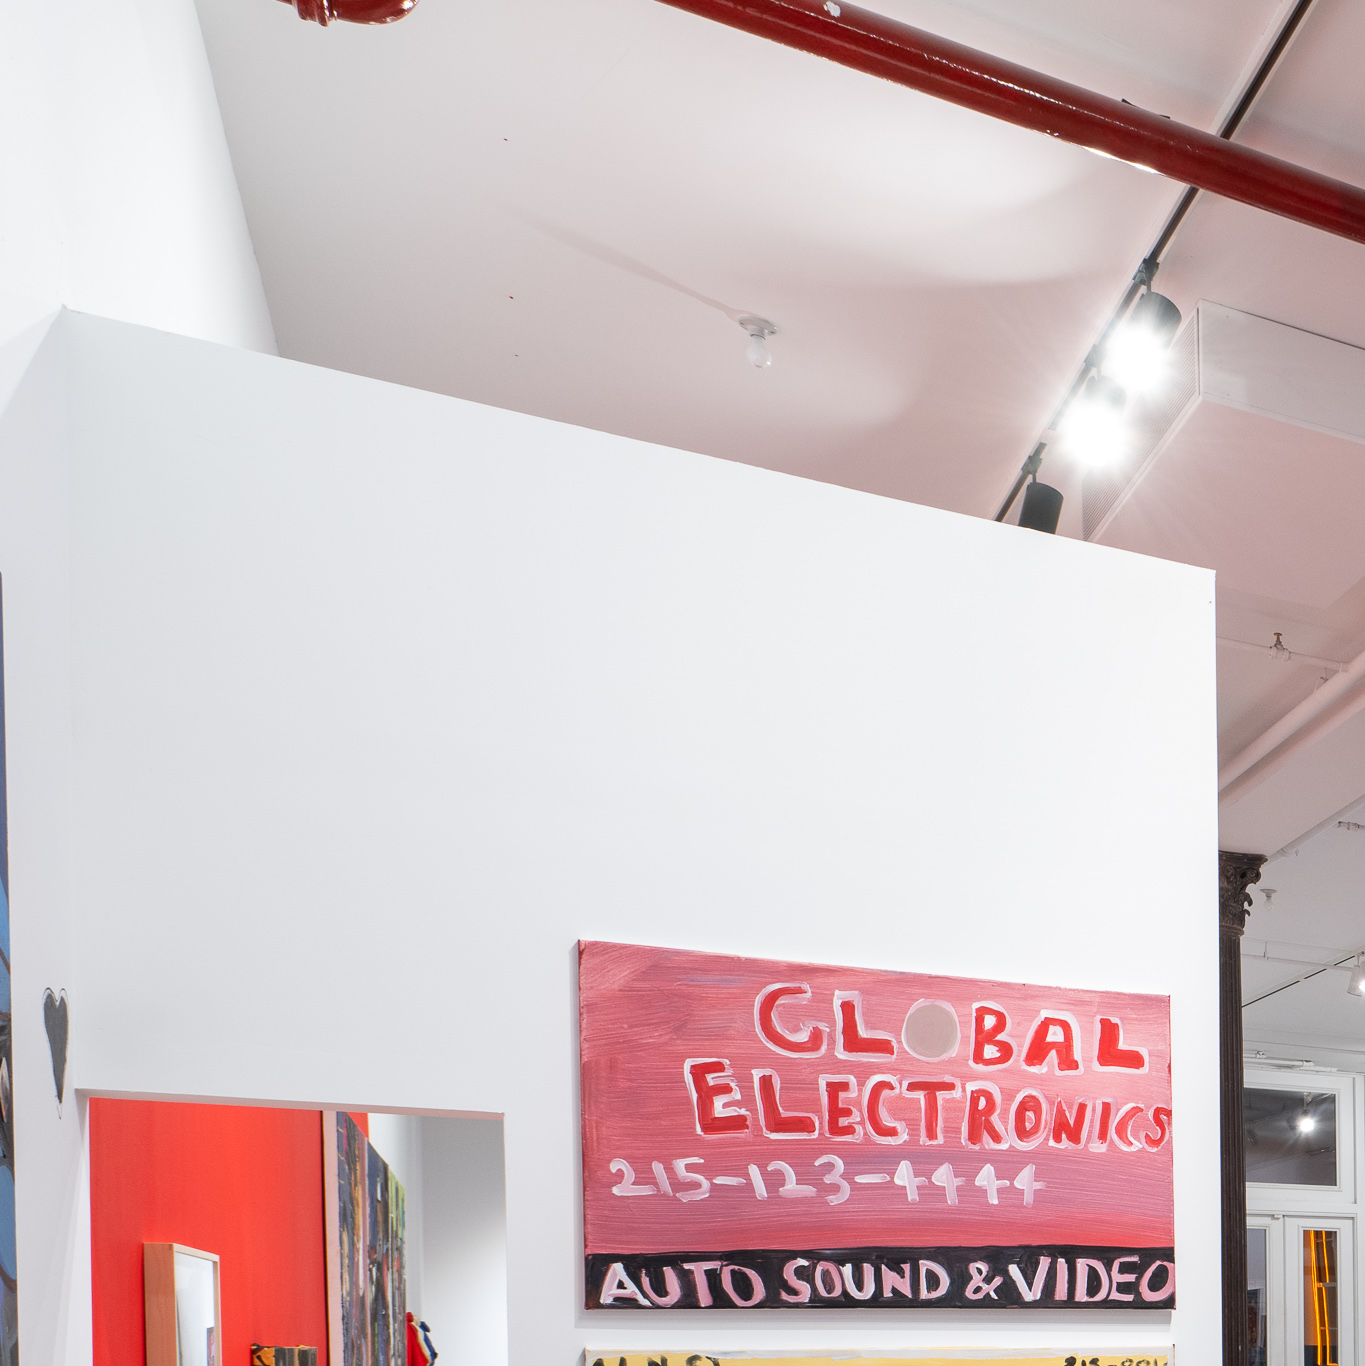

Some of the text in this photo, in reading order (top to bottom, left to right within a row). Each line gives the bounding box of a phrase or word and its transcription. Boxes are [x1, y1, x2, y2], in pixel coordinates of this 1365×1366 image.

[754, 981, 1149, 1075] GLOBAL
[684, 1058, 1171, 1151] ELECTRONICS
[608, 1155, 1047, 1206] 215-123-4444
[599, 1256, 1176, 1308] AUTO SOUND & VIDEO
